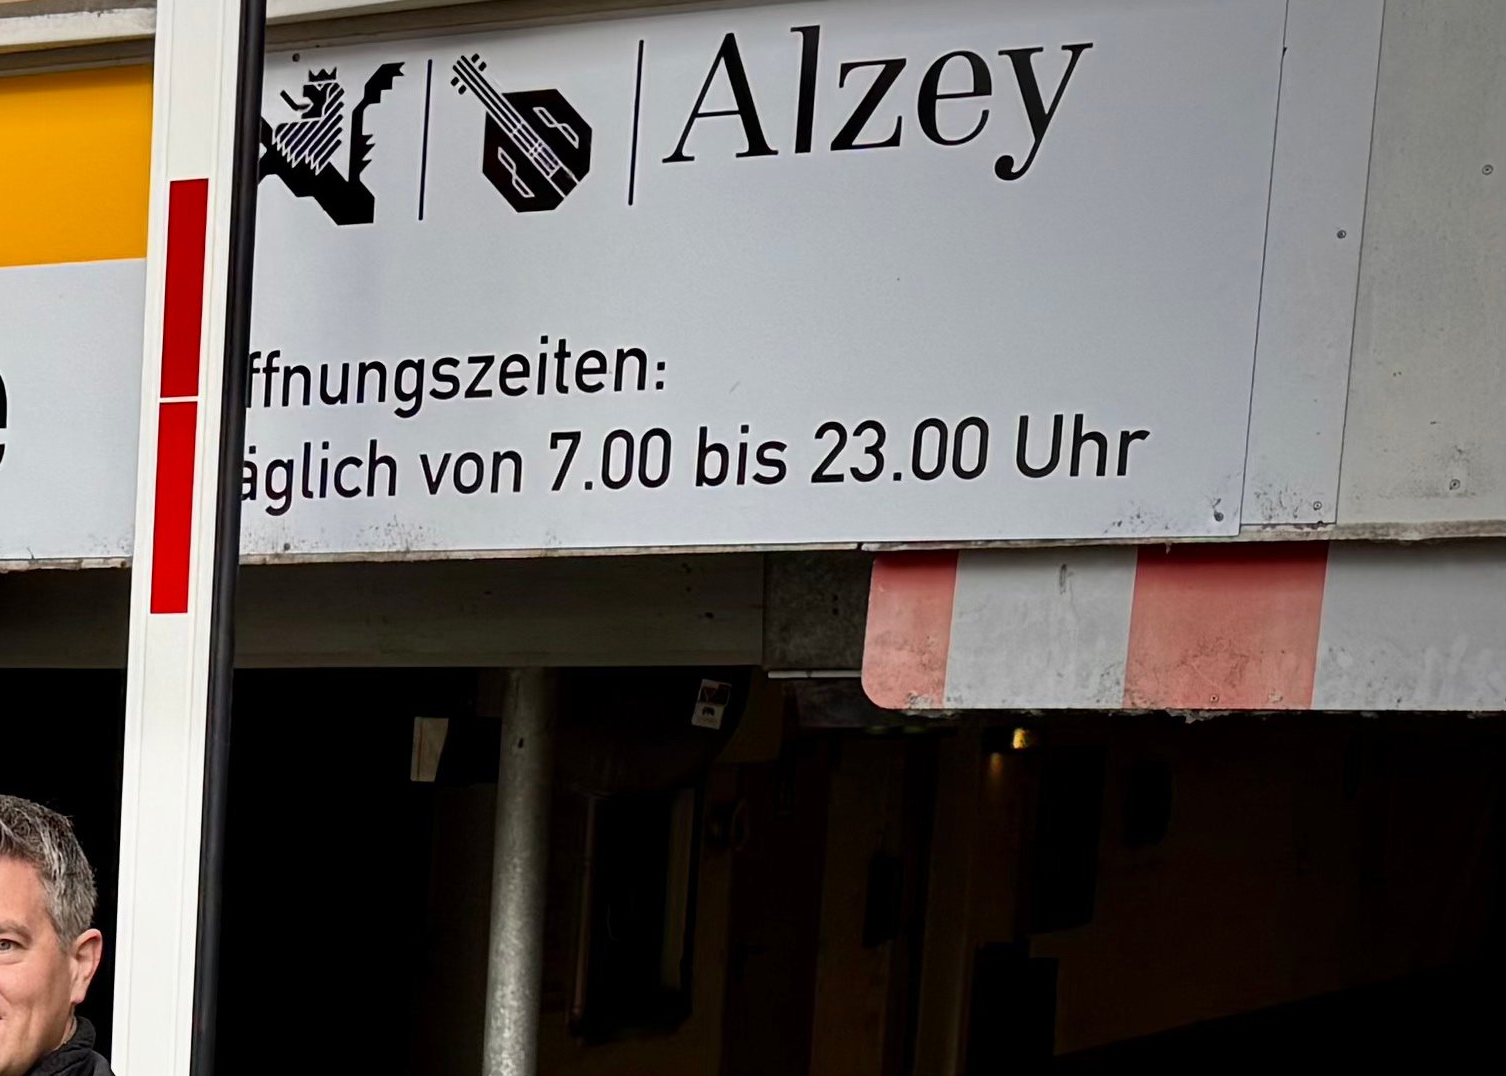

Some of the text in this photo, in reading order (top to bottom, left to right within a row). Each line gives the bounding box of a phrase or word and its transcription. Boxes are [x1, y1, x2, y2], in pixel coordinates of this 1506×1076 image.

[662, 25, 1094, 181] Alzey
[245, 335, 667, 419] ffnungszeiten:
[242, 413, 1151, 517] äglich von 7.00 bis 23.00 Uhr
